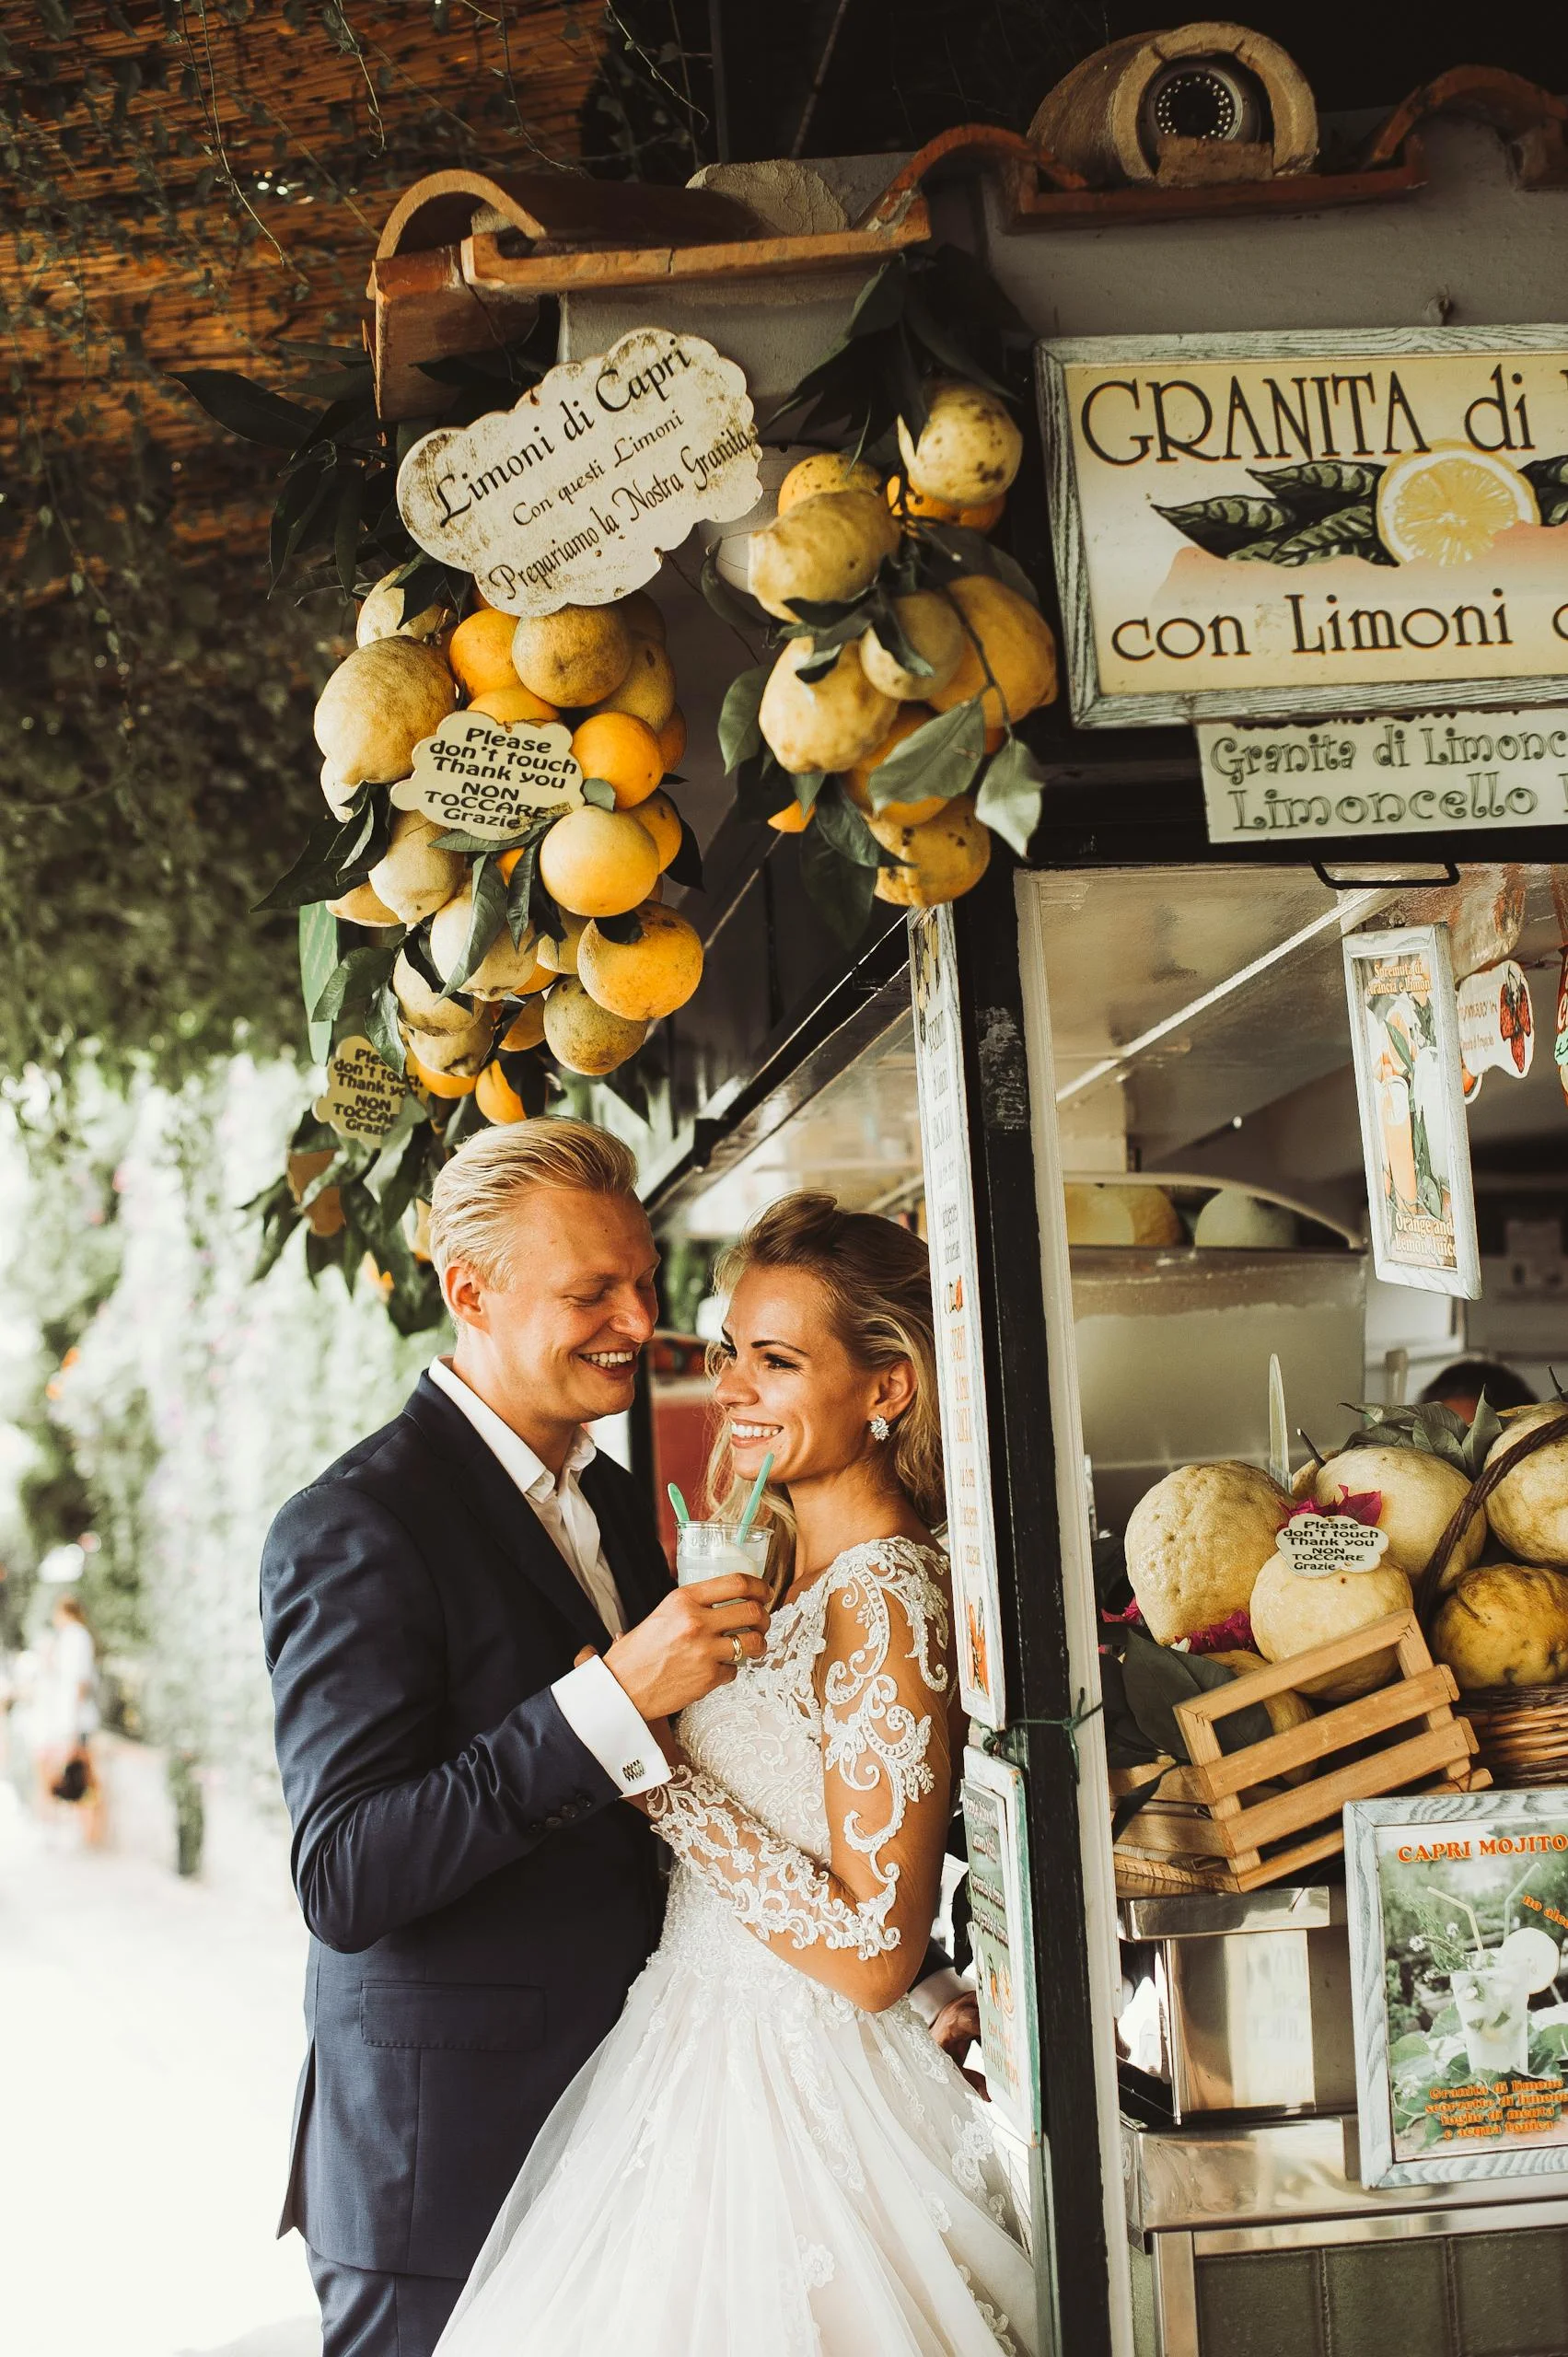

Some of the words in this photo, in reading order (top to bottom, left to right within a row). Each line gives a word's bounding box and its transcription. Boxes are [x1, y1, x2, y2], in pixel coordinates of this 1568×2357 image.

[1081, 370, 1432, 466] GRANITA
[1465, 364, 1536, 453] di
[436, 427, 554, 528] Limoni
[560, 400, 595, 441] di
[595, 339, 690, 412] Capri
[513, 496, 552, 526] Con
[558, 460, 605, 505] questi
[614, 410, 684, 469] Limoni
[489, 526, 598, 599] Prepariamo
[589, 508, 619, 540] la
[612, 473, 682, 521] Nostra
[680, 429, 751, 491] Granita
[1111, 613, 1251, 661] con
[1284, 587, 1514, 655] Limoni
[465, 727, 552, 753] Please
[430, 740, 497, 762] don't
[507, 751, 576, 774] touch
[1210, 734, 1356, 784] Granita
[1374, 725, 1411, 767] di
[433, 756, 510, 781] Thank
[519, 772, 565, 791] you
[461, 782, 519, 801] NON
[1227, 772, 1538, 831] Limoncello
[424, 790, 550, 819] TOCCARE
[444, 808, 521, 829] Grazie
[1414, 957, 1423, 974] di
[355, 1049, 387, 1066] Ple
[334, 1059, 375, 1077] don't
[337, 1073, 384, 1094] Thank
[333, 1103, 400, 1123] TOCCA
[355, 1095, 390, 1112] NON
[1395, 1212, 1432, 1238] Orange
[1434, 1217, 1454, 1237] and
[1394, 1232, 1428, 1253] Lemon
[1283, 1528, 1327, 1538] don't
[1333, 1529, 1379, 1538] touch
[1304, 1521, 1359, 1529] Please
[1287, 1537, 1339, 1546] Thank
[1292, 1553, 1365, 1562] TOCCARE
[1294, 1562, 1336, 1571] Grazie
[1398, 1840, 1471, 1864] CAPRI
[1479, 1833, 1568, 1857] MOJITO
[1521, 1895, 1542, 1912] no
[1493, 2081, 1508, 2095] di
[1499, 2096, 1515, 2107] di
[1487, 2108, 1503, 2121] di
[1444, 2129, 1453, 2140] e
